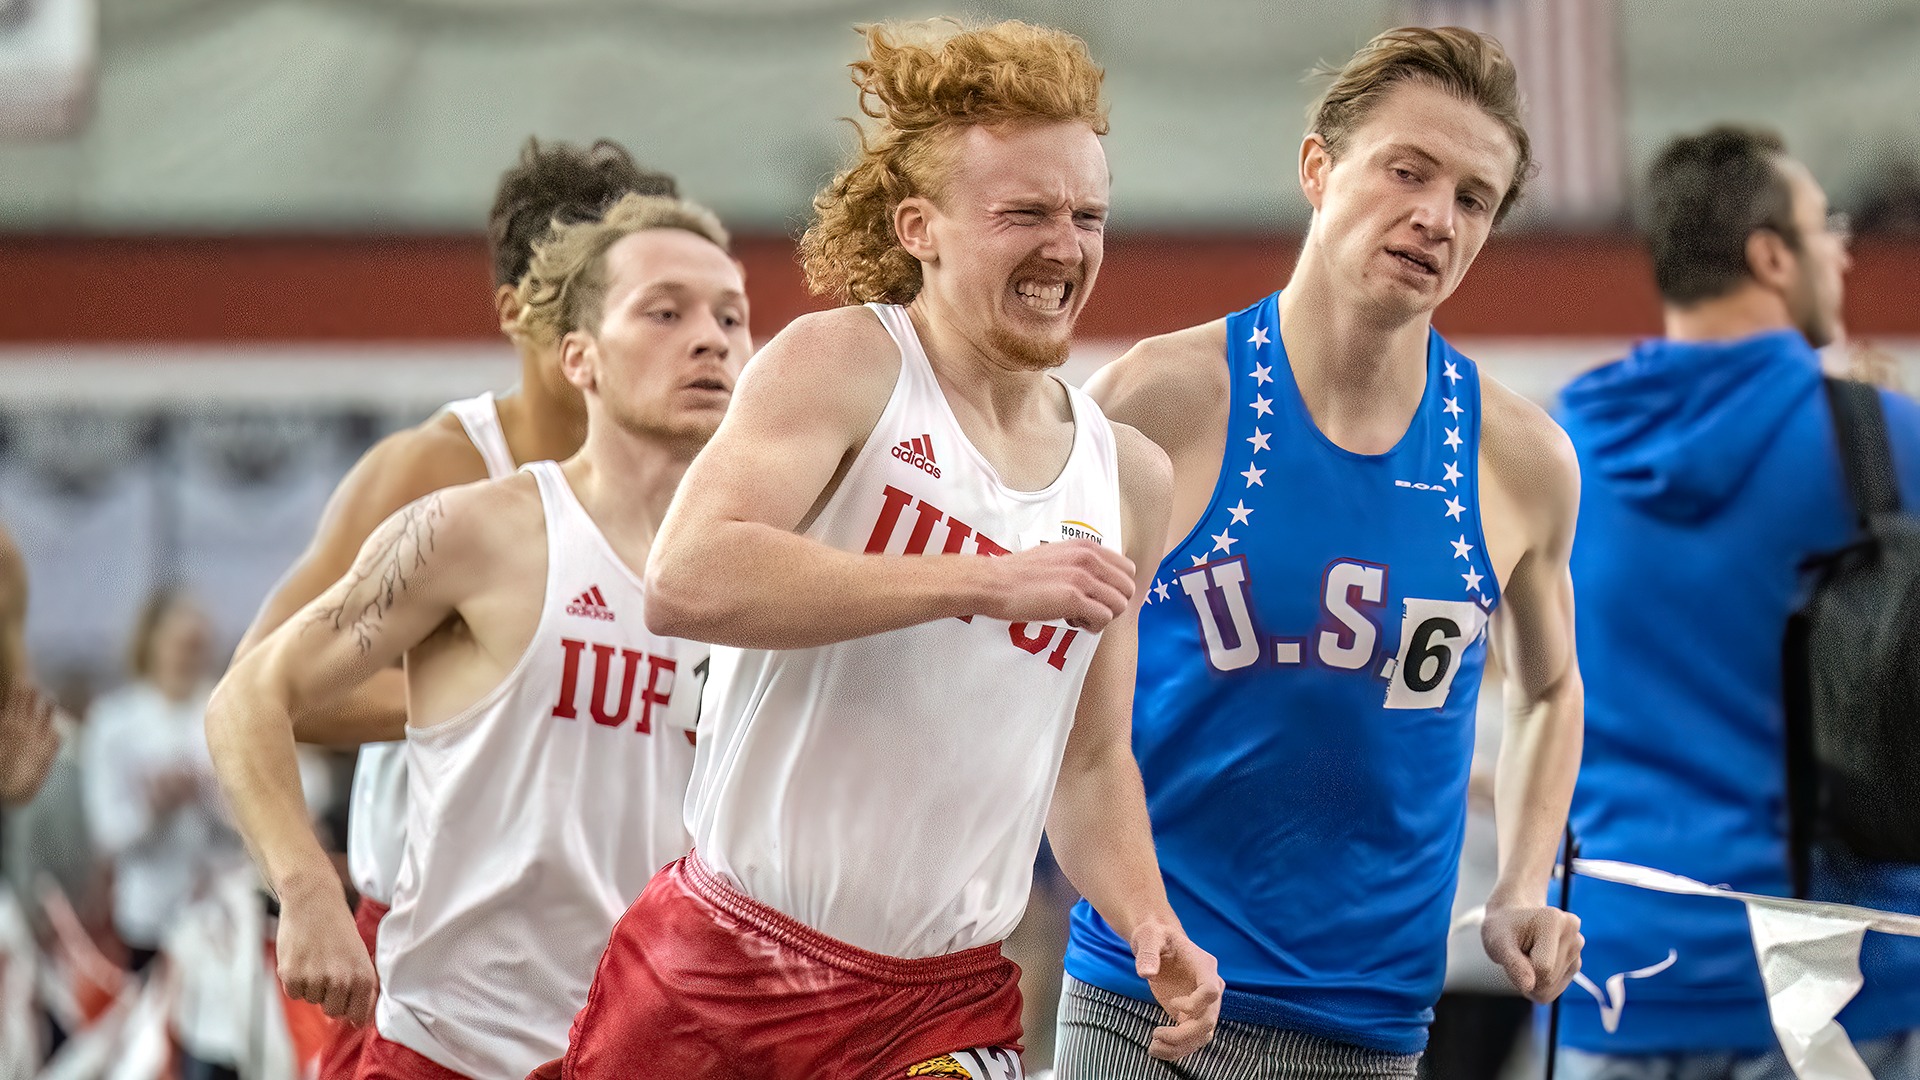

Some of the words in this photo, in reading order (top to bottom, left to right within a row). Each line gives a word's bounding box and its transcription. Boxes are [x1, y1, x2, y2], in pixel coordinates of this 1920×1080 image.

[891, 446, 942, 479] adidas
[1061, 525, 1102, 546] HORIZON
[566, 605, 615, 622] adidas
[1403, 617, 1461, 692] 6
[552, 638, 697, 747] IUP
